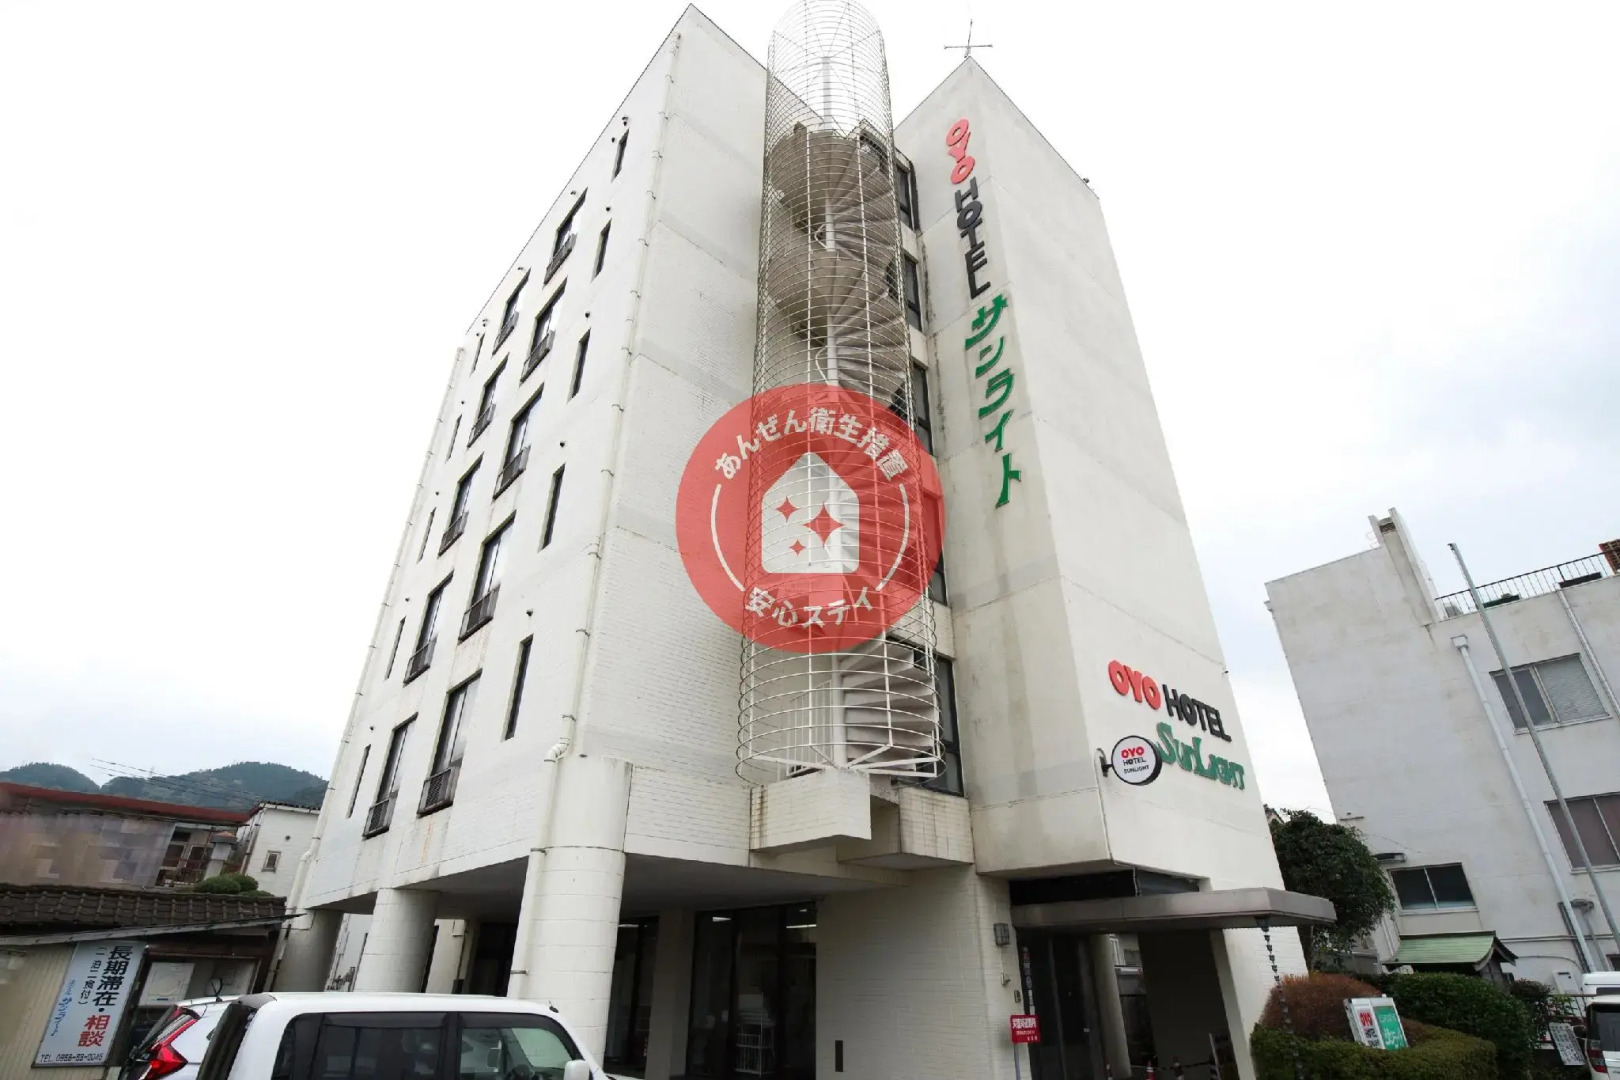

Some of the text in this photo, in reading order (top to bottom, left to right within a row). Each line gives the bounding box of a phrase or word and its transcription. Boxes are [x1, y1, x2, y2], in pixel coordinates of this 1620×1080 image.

[946, 119, 991, 300] OYO HOTEL
[965, 294, 1022, 509] サンライト
[1108, 659, 1232, 742] OYO HOTEL
[1121, 746, 1145, 759] OYO
[1122, 757, 1147, 767] HOTEL
[1123, 764, 1150, 774] SUNLIGHT
